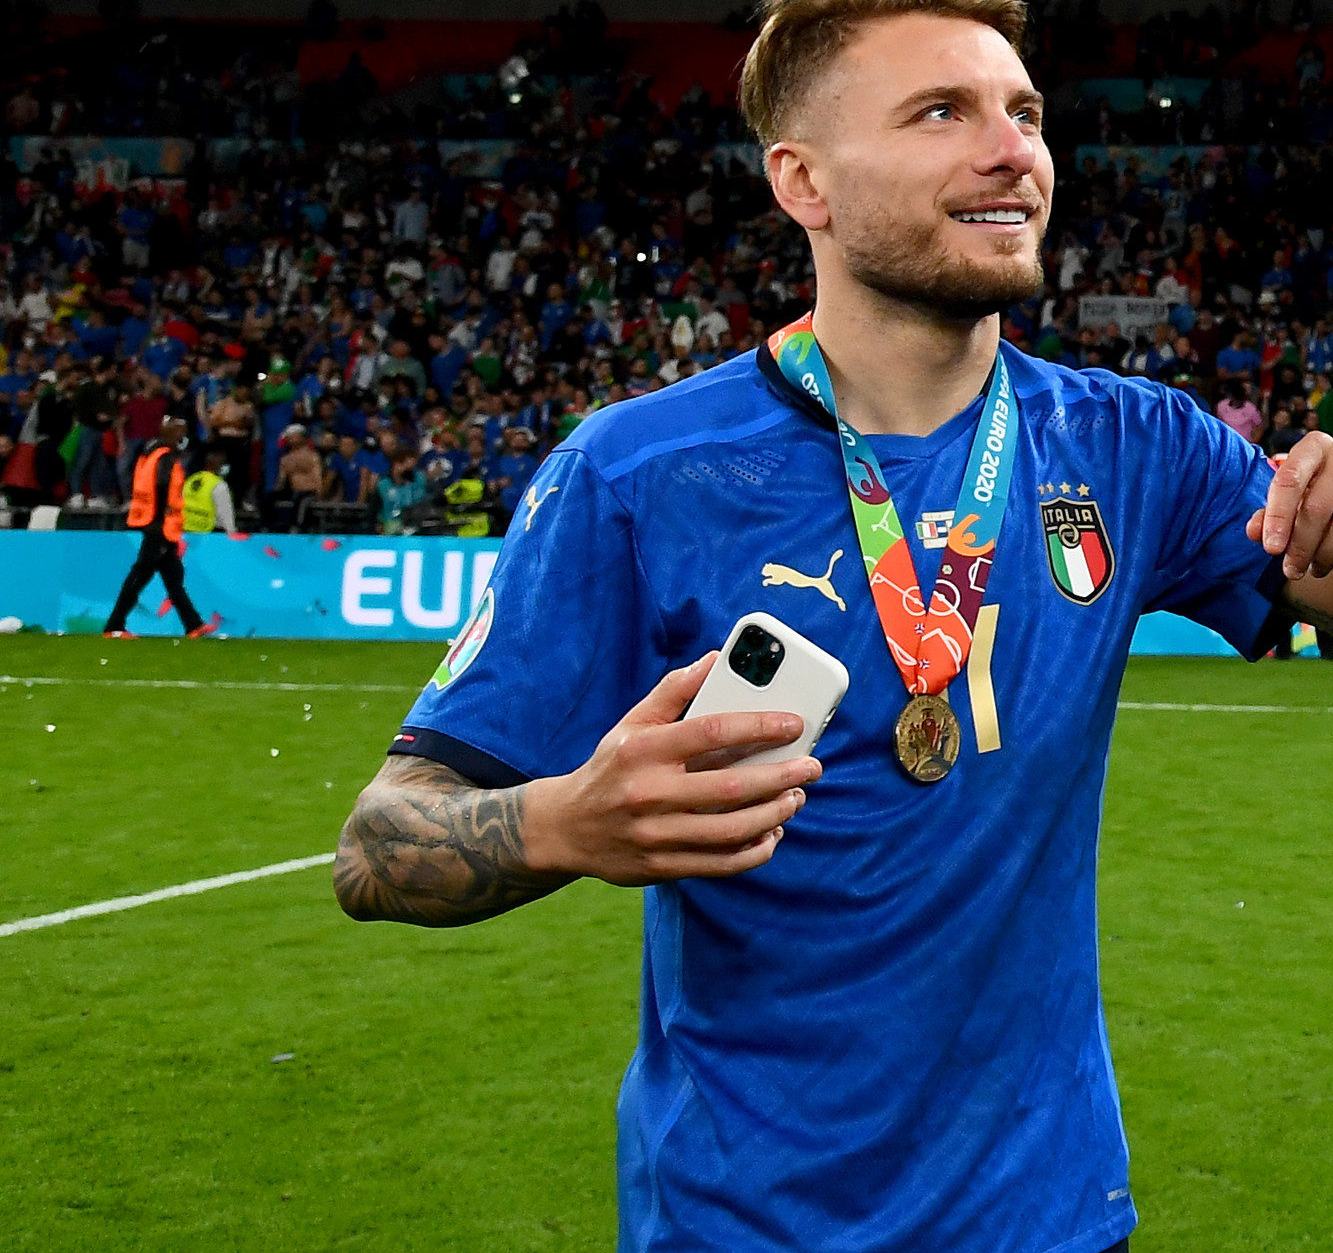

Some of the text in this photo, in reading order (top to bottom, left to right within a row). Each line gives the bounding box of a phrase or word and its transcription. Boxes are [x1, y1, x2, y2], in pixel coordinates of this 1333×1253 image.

[986, 398, 1009, 452] EURO
[973, 450, 1000, 503] 2020
[1043, 508, 1094, 525] ITALIA
